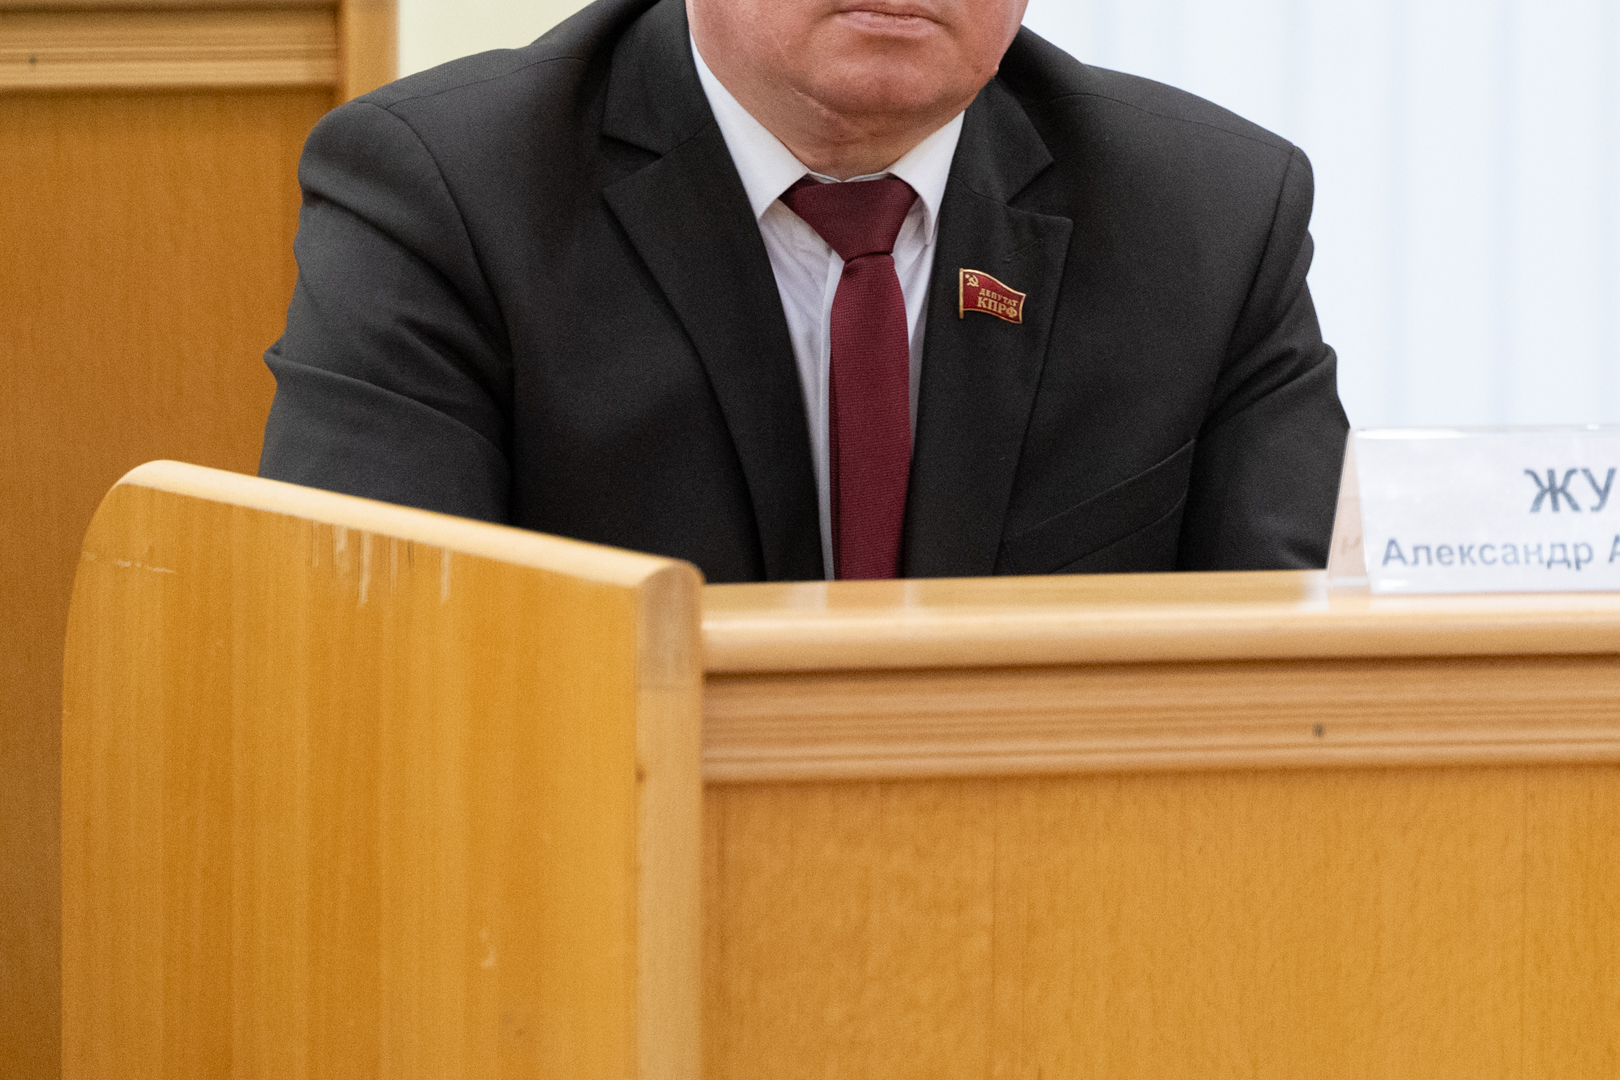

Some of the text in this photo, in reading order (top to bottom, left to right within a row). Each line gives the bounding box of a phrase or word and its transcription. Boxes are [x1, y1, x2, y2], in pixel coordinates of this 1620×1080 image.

[977, 296, 1018, 318] КПРФ
[979, 288, 1019, 307] ДЕПУТАТ
[1382, 538, 1594, 571] Александр
